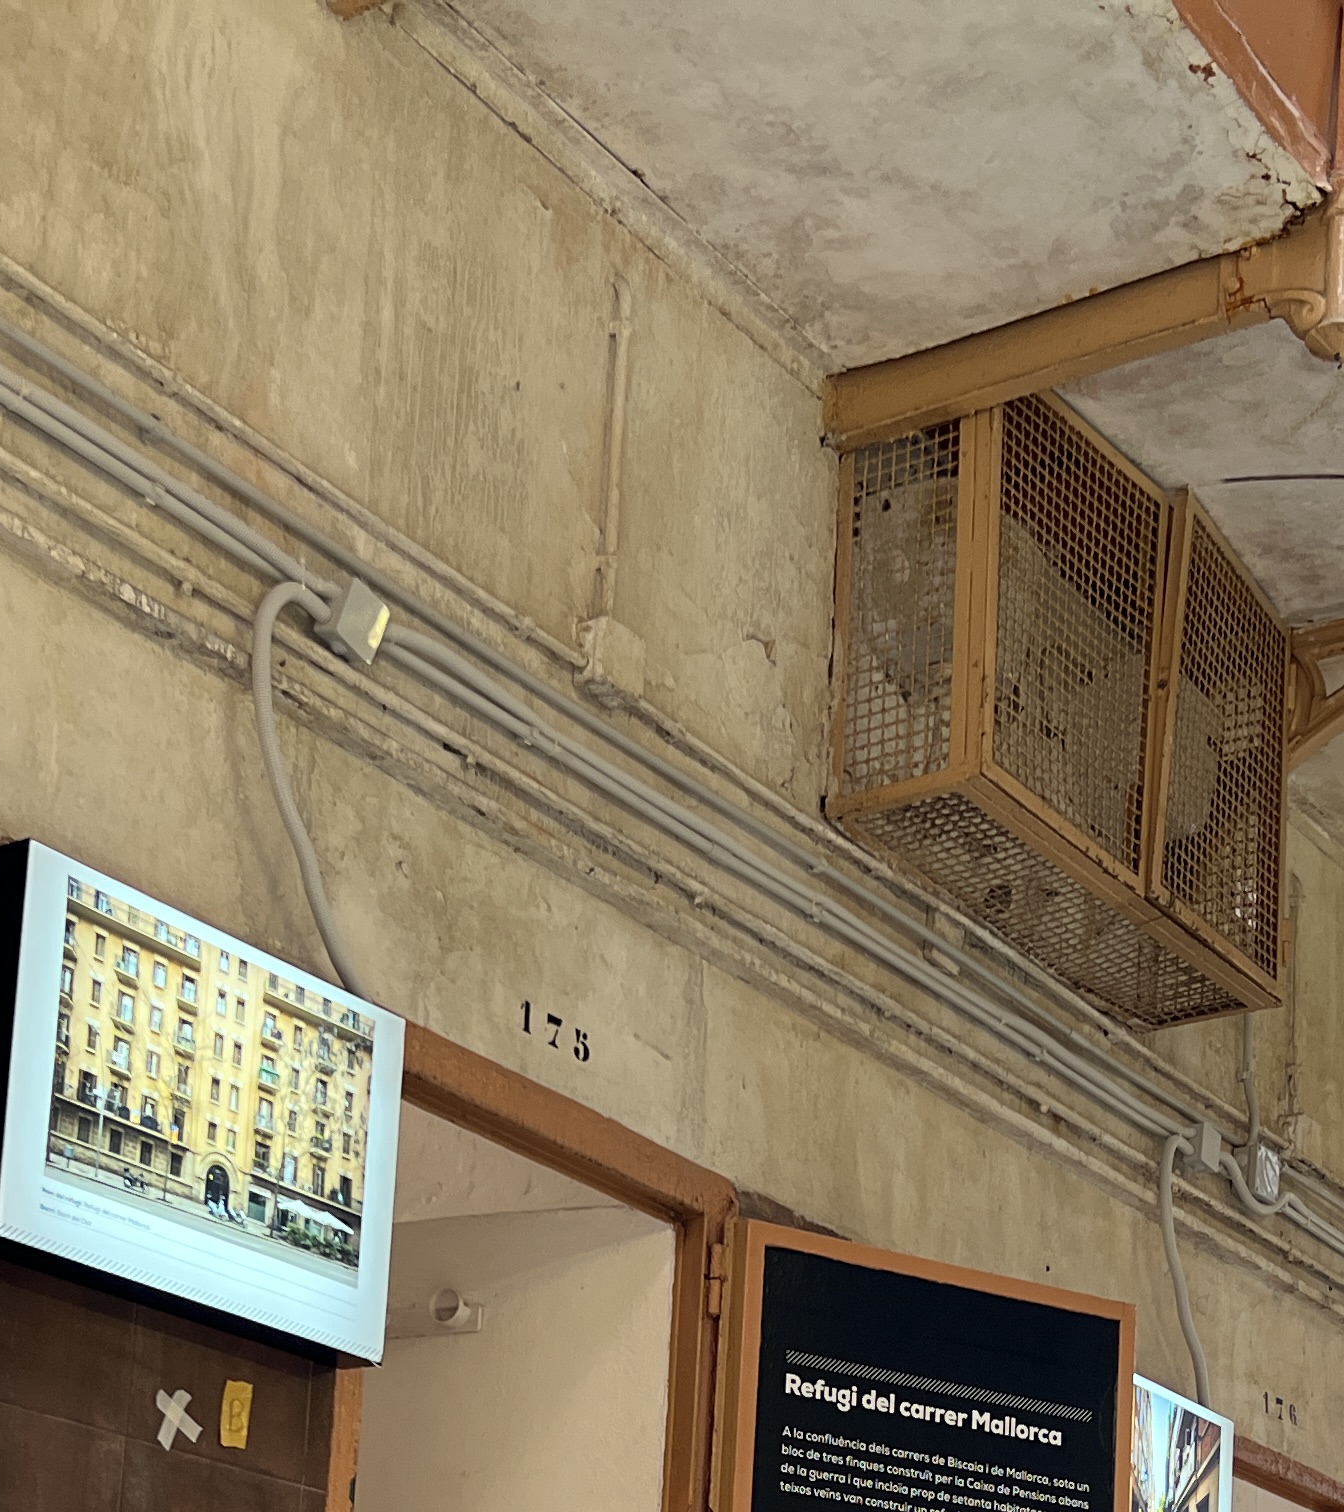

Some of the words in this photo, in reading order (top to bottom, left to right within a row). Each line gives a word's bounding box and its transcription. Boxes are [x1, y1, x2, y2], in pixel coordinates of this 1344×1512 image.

[519, 1000, 592, 1063] 175
[228, 1398, 245, 1433] B
[785, 1373, 857, 1411] Refugi
[862, 1389, 895, 1413] del
[899, 1401, 968, 1427] carrer
[971, 1409, 1062, 1446] Mallorca
[1262, 1391, 1298, 1426] 176
[781, 1444, 804, 1457] bloc
[806, 1449, 820, 1460] de
[822, 1452, 843, 1464] tres
[846, 1455, 884, 1472] finques
[935, 1474, 953, 1484] per
[955, 1475, 964, 1486] la
[997, 1484, 1010, 1495] de
[1012, 1486, 1056, 1503] Pensions
[1058, 1496, 1089, 1509] abans
[782, 1425, 791, 1437] A
[793, 1427, 803, 1439] la
[806, 1432, 866, 1450] confluència
[868, 1442, 890, 1455] dels
[892, 1448, 930, 1463] carrers
[932, 1454, 945, 1465] de
[991, 1465, 1004, 1476] de
[1053, 1478, 1075, 1489] sota
[1077, 1483, 1089, 1492] un
[843, 1493, 863, 1504] van
[865, 1497, 912, 1512] construir
